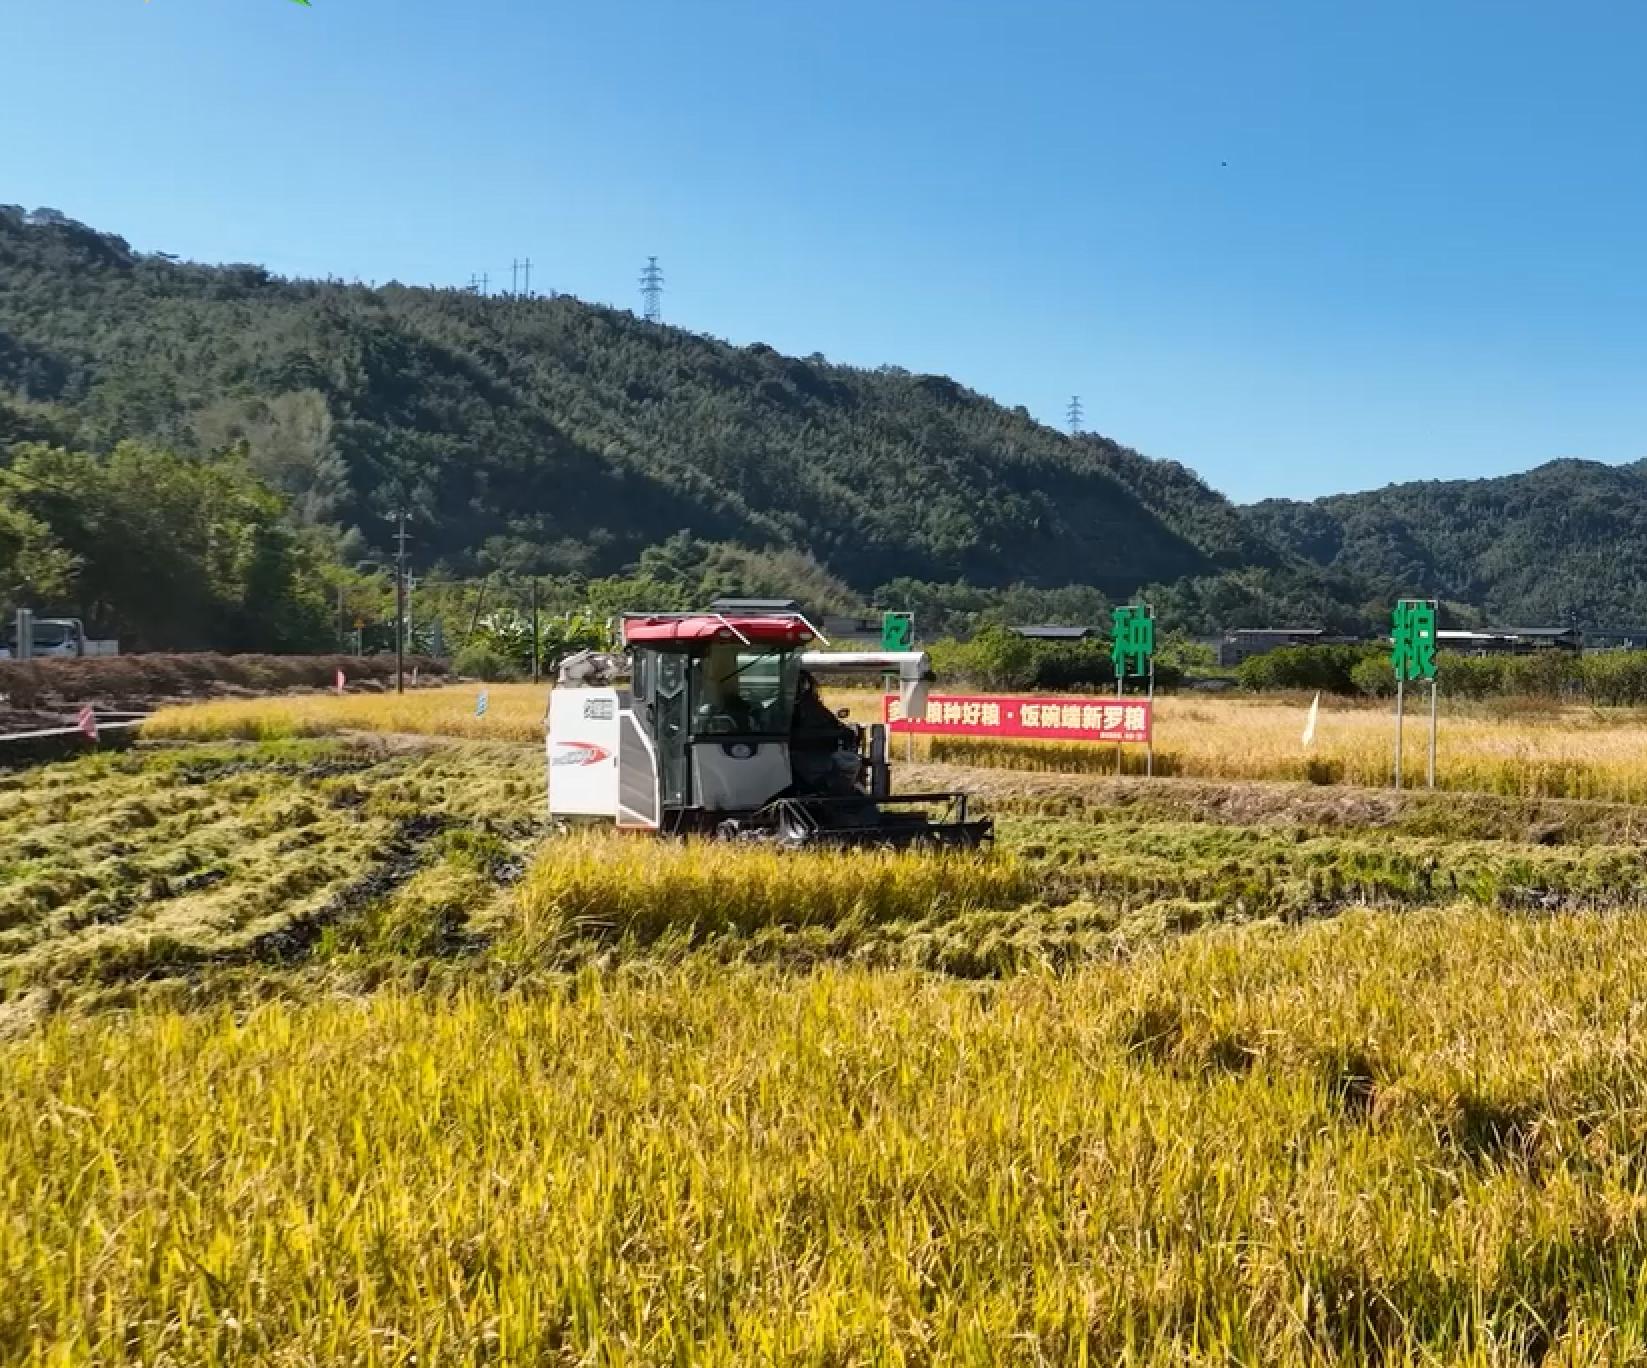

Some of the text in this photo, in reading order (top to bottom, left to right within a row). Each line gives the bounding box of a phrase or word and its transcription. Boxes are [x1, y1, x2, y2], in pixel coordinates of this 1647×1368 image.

[1112, 602, 1153, 677] 种
[1391, 600, 1437, 680] 粮
[888, 700, 1145, 730] 多粮种好粮·饭碗端新罗粮
